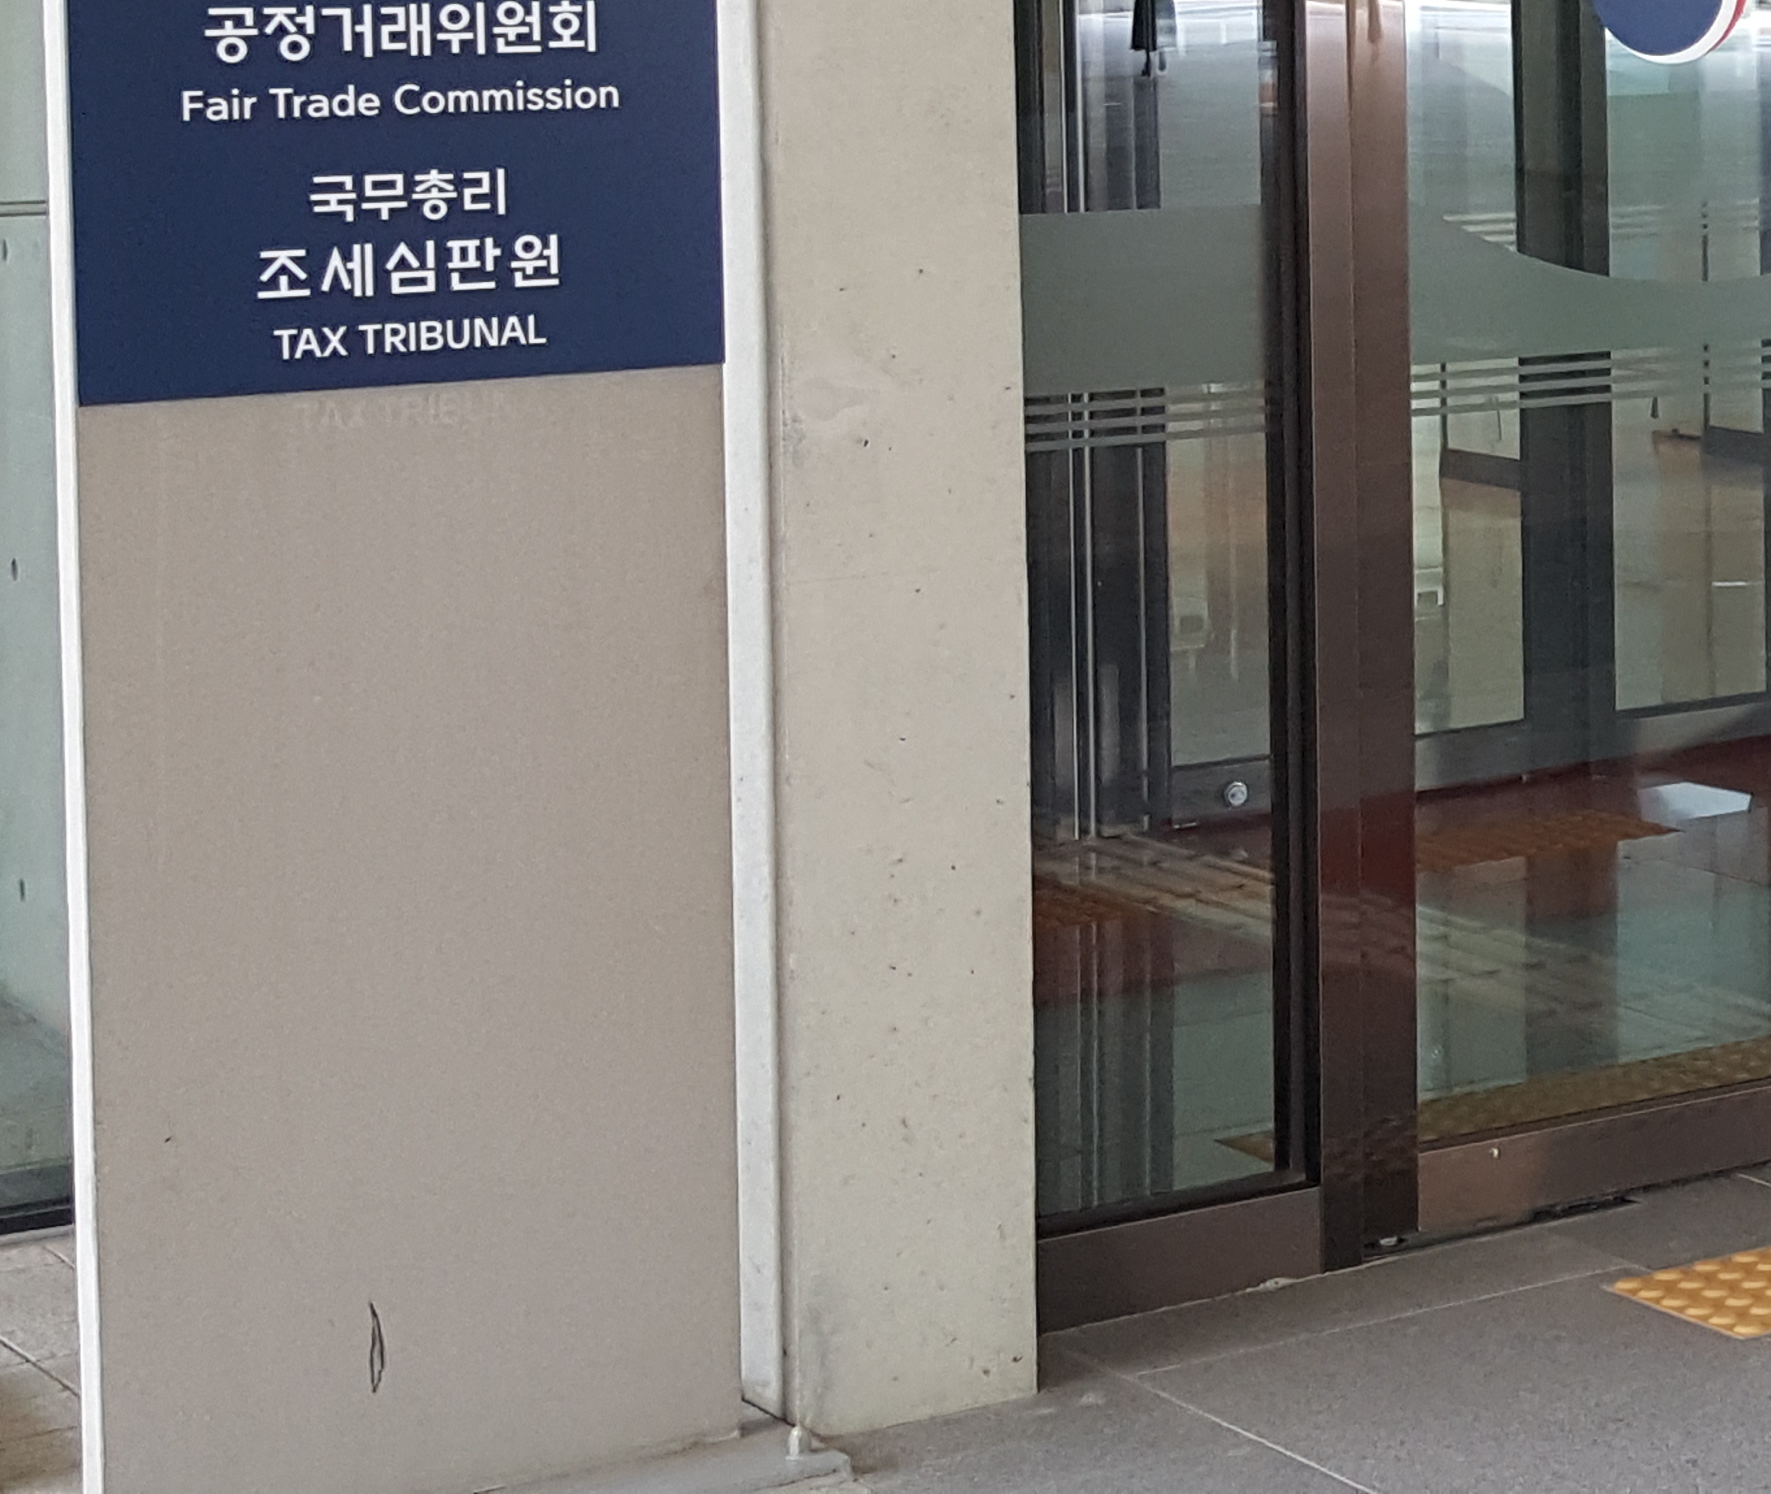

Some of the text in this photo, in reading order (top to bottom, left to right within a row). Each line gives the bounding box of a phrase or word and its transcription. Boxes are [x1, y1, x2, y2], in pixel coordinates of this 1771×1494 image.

[204, 0, 598, 63] 공정거래위원회
[181, 78, 620, 122] Fair Trade Commission
[309, 167, 507, 223] 국무총리
[256, 233, 561, 301] 조세심판원
[272, 313, 548, 360] TAX TRIBUNAL
